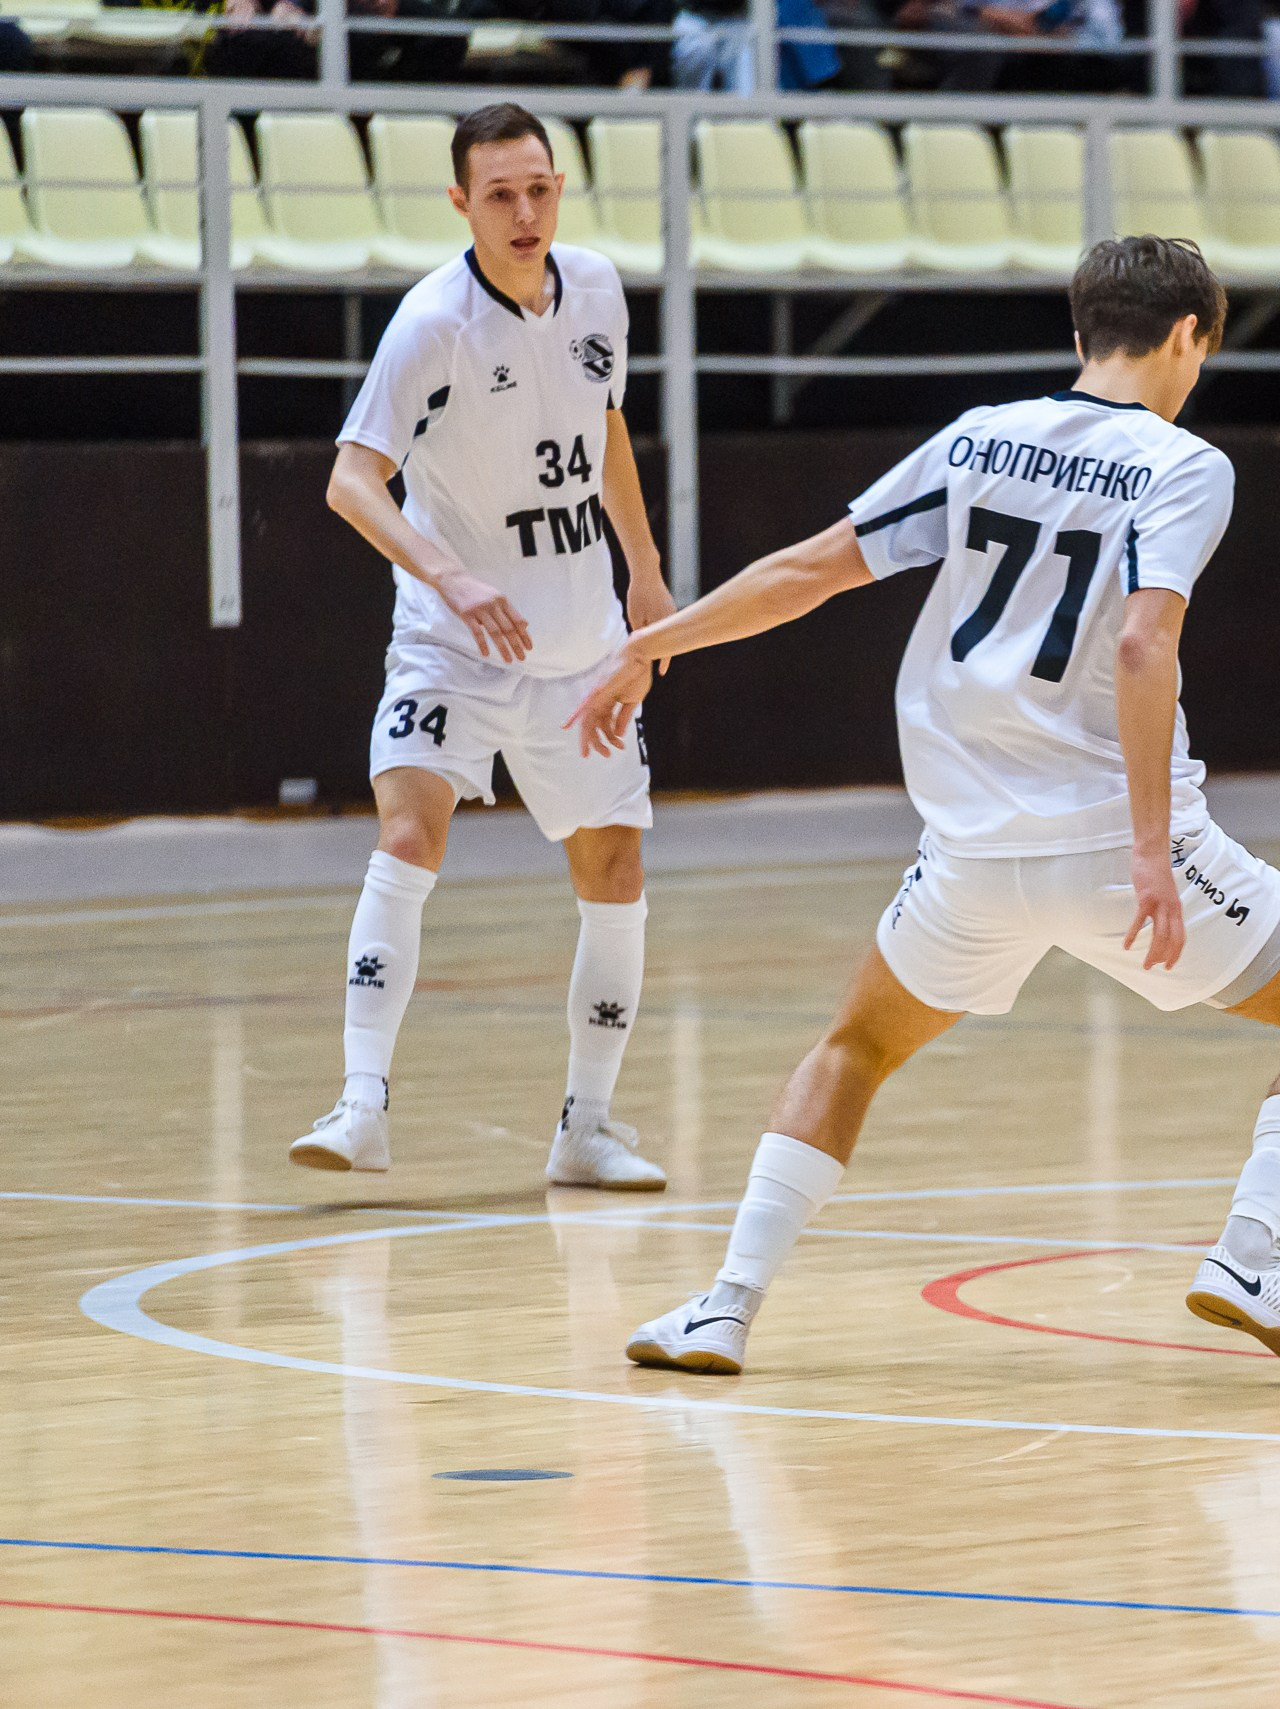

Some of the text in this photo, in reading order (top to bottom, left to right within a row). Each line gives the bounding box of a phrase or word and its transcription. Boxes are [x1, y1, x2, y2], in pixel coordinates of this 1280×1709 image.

[535, 434, 592, 488] 34
[948, 436, 1152, 502] ОНОПРИЕНКО
[950, 506, 1102, 684] 71
[388, 699, 448, 748] 34
